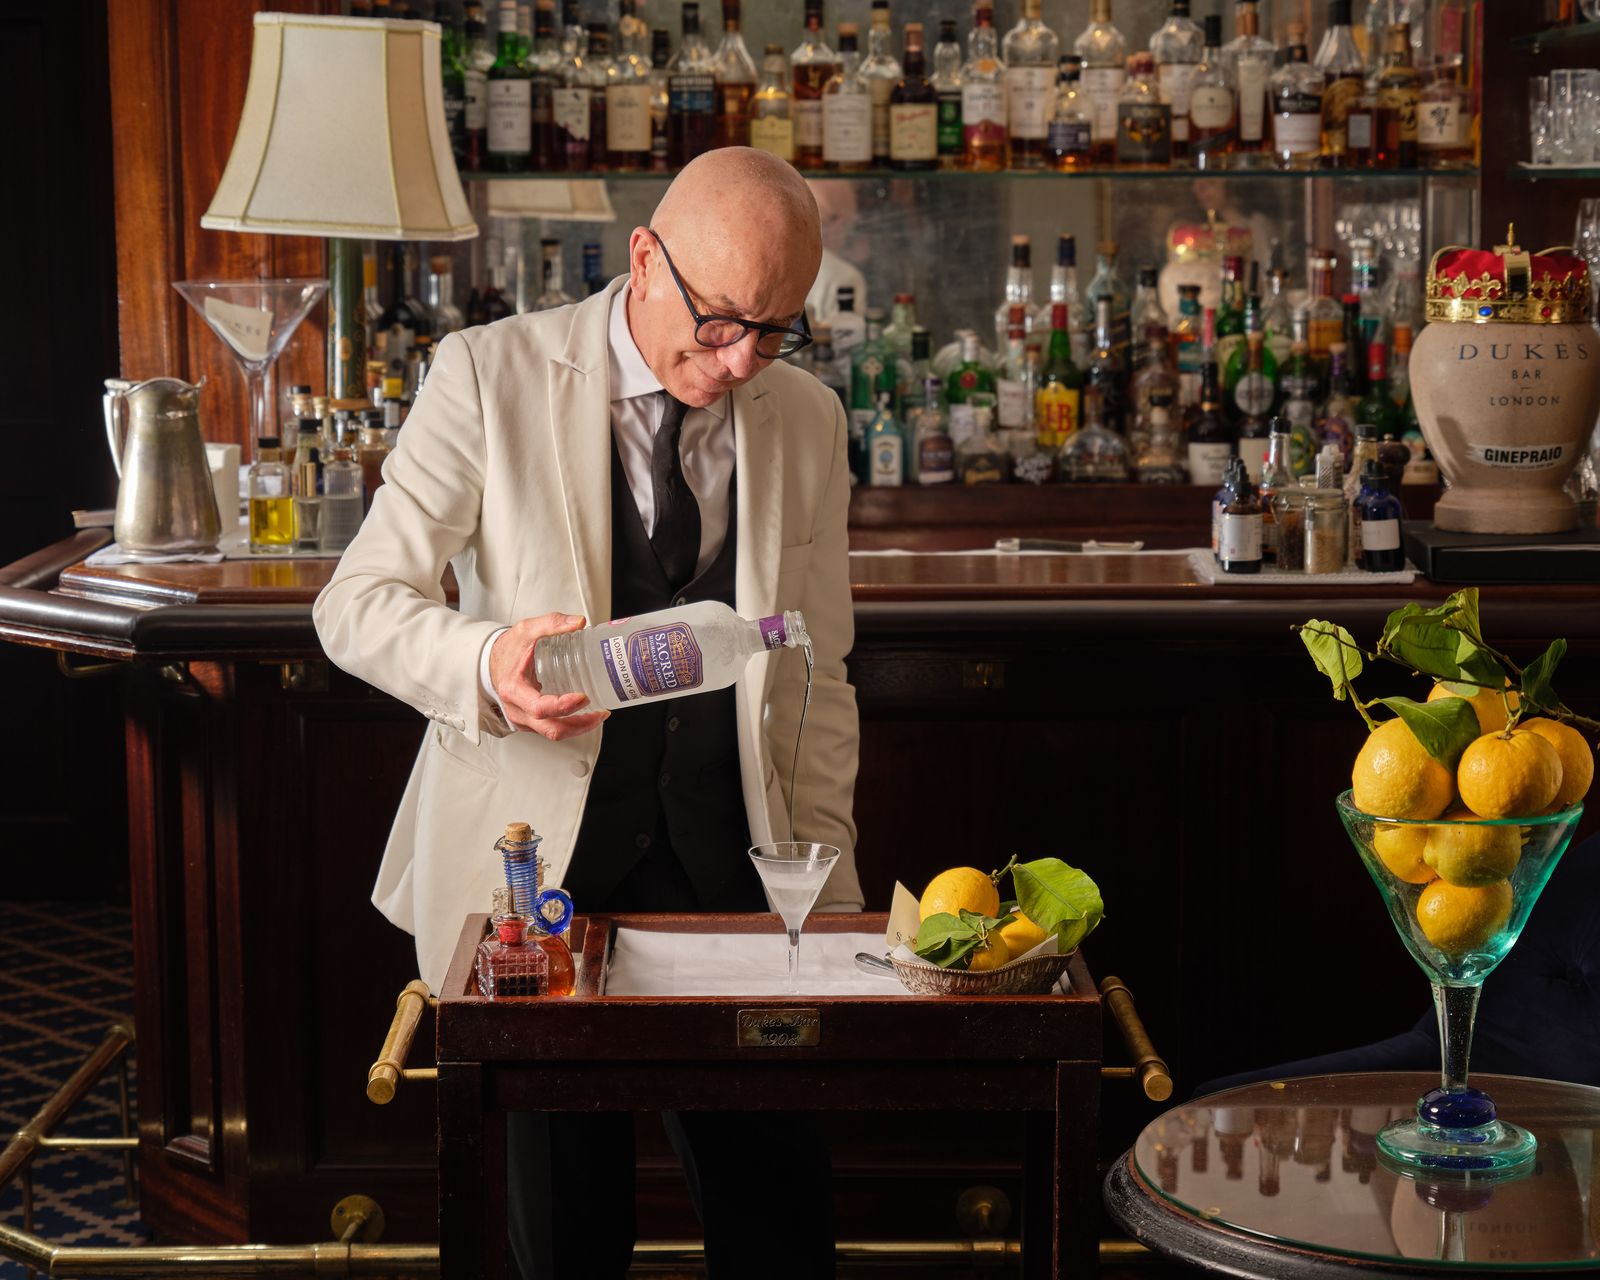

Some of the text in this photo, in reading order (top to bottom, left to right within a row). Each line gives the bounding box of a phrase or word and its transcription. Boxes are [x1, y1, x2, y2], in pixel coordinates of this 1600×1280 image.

[1458, 343, 1589, 360] DUKES
[1511, 369, 1542, 380] BAR
[1489, 396, 1560, 407] LONDON
[1484, 446, 1562, 464] GINEPRAIO
[613, 637, 627, 672] LONDON
[622, 672, 633, 689] DRY
[655, 632, 678, 688] SACRED
